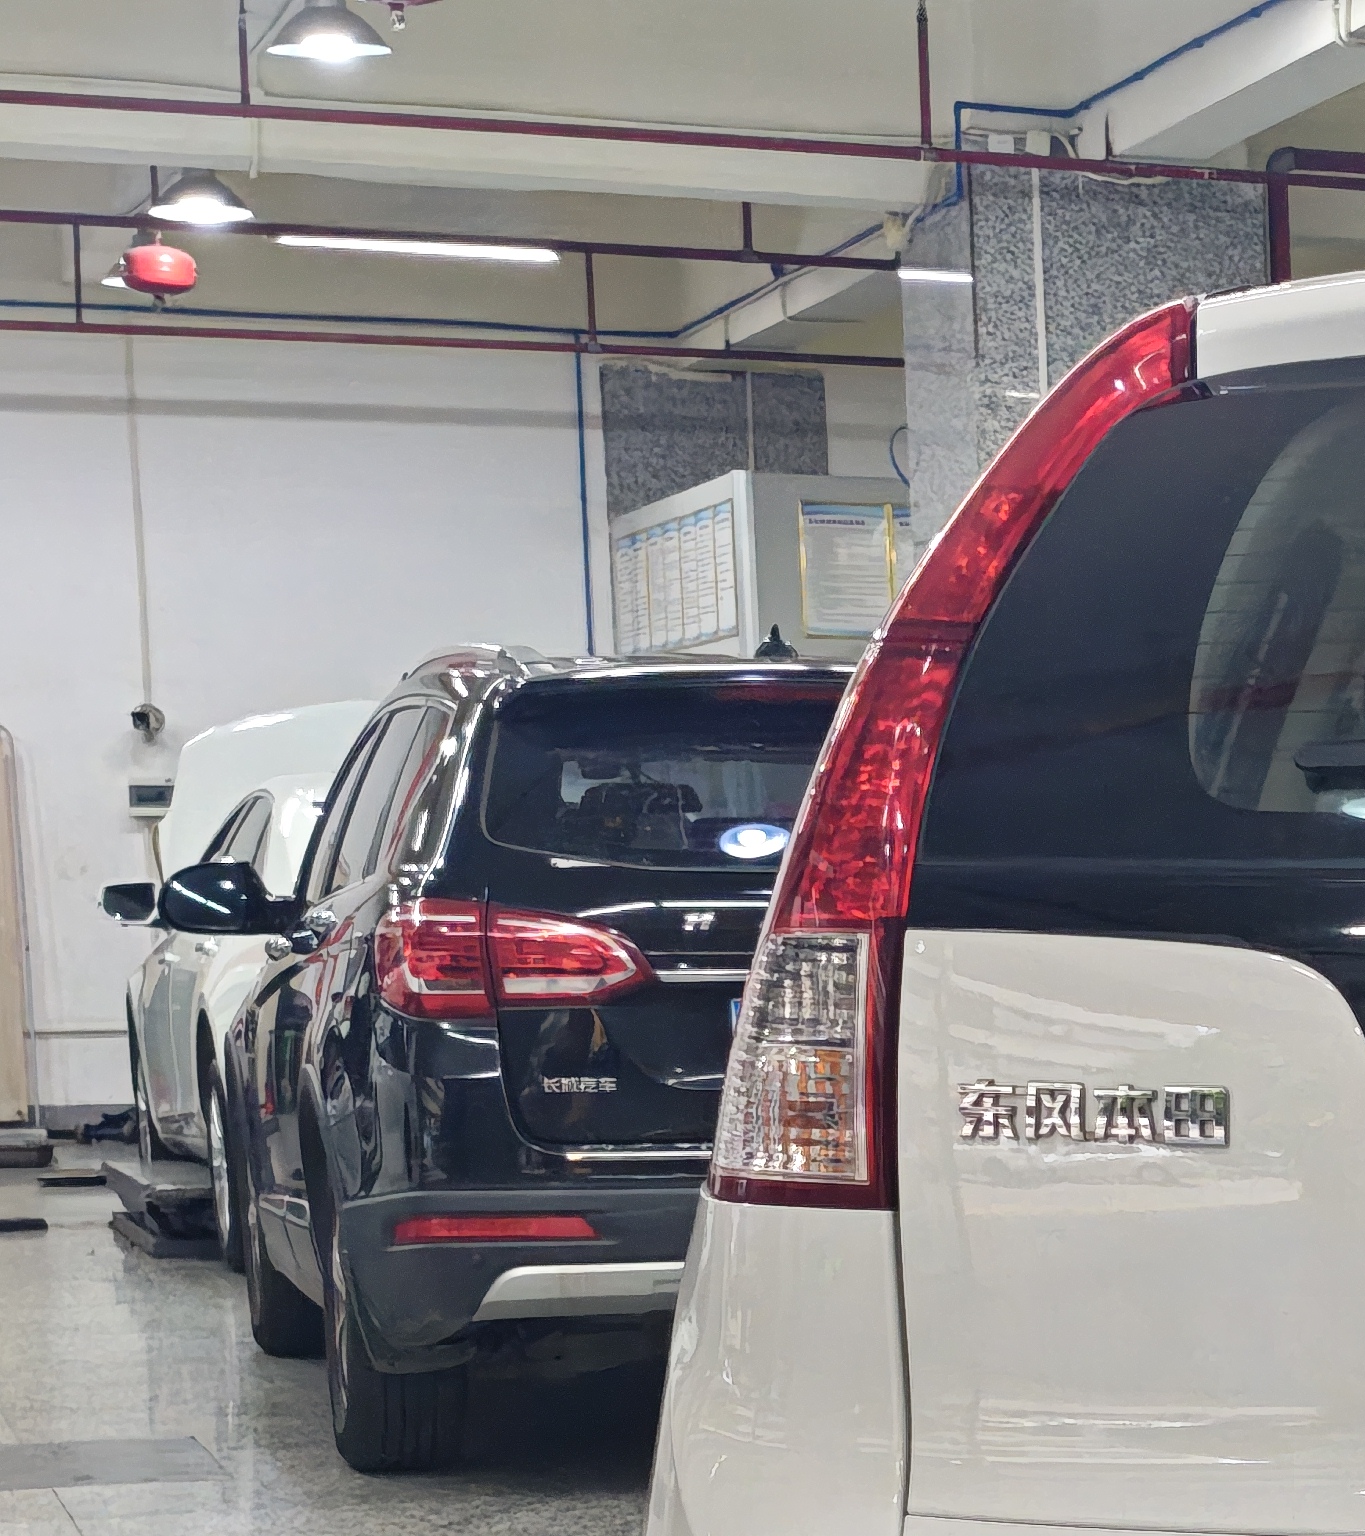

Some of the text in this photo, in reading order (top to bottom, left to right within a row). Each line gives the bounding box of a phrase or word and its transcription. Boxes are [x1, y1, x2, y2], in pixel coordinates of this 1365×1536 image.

[543, 1076, 618, 1094] 长城汽车
[956, 1078, 1231, 1149] 东风本田
